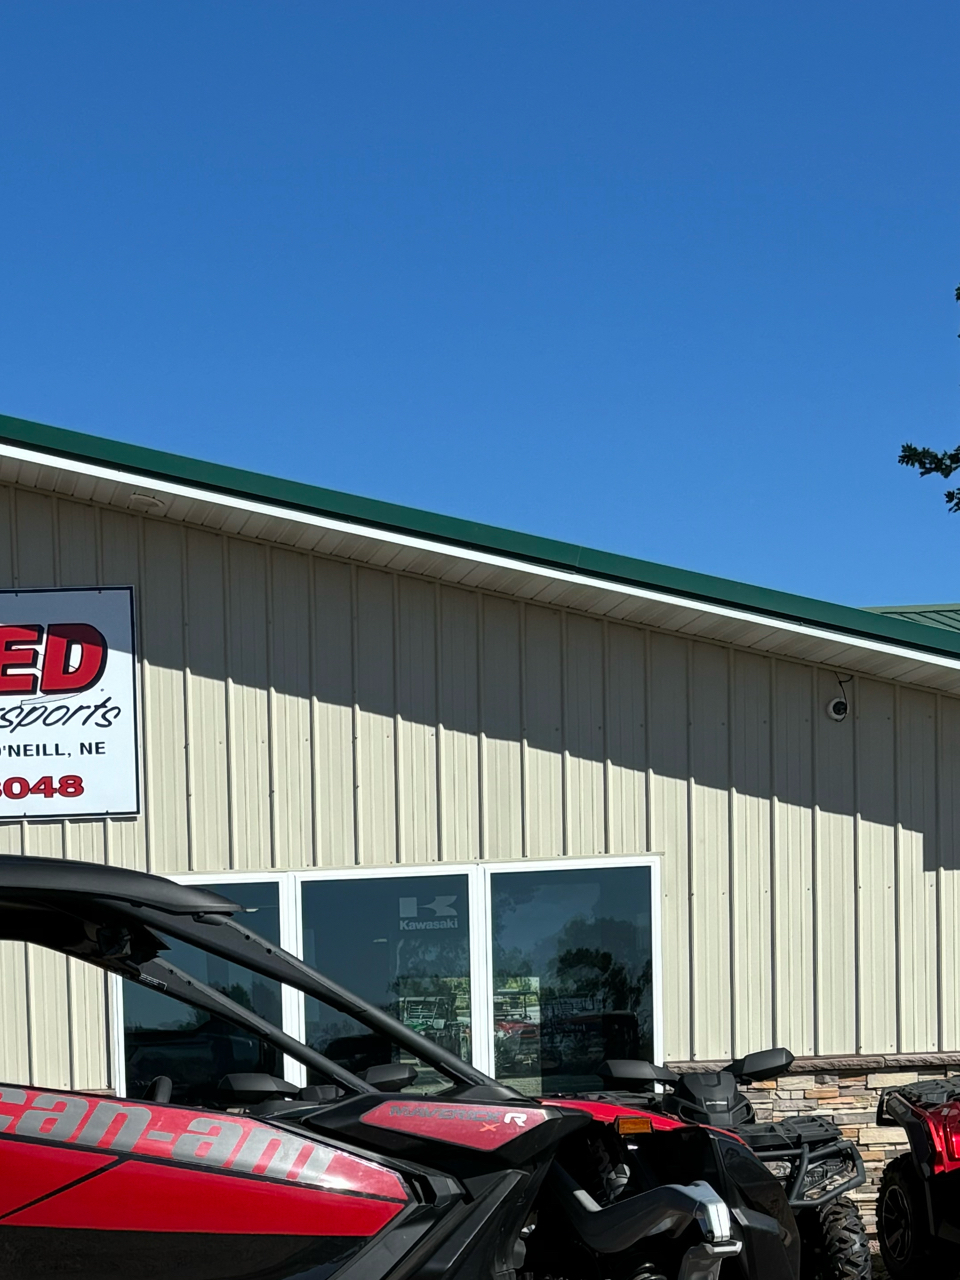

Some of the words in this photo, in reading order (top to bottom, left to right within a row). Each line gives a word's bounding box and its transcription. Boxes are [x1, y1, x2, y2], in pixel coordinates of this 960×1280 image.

[79, 741, 106, 756] NE
[399, 918, 458, 930] Kawasaki
[503, 1112, 528, 1127] R
